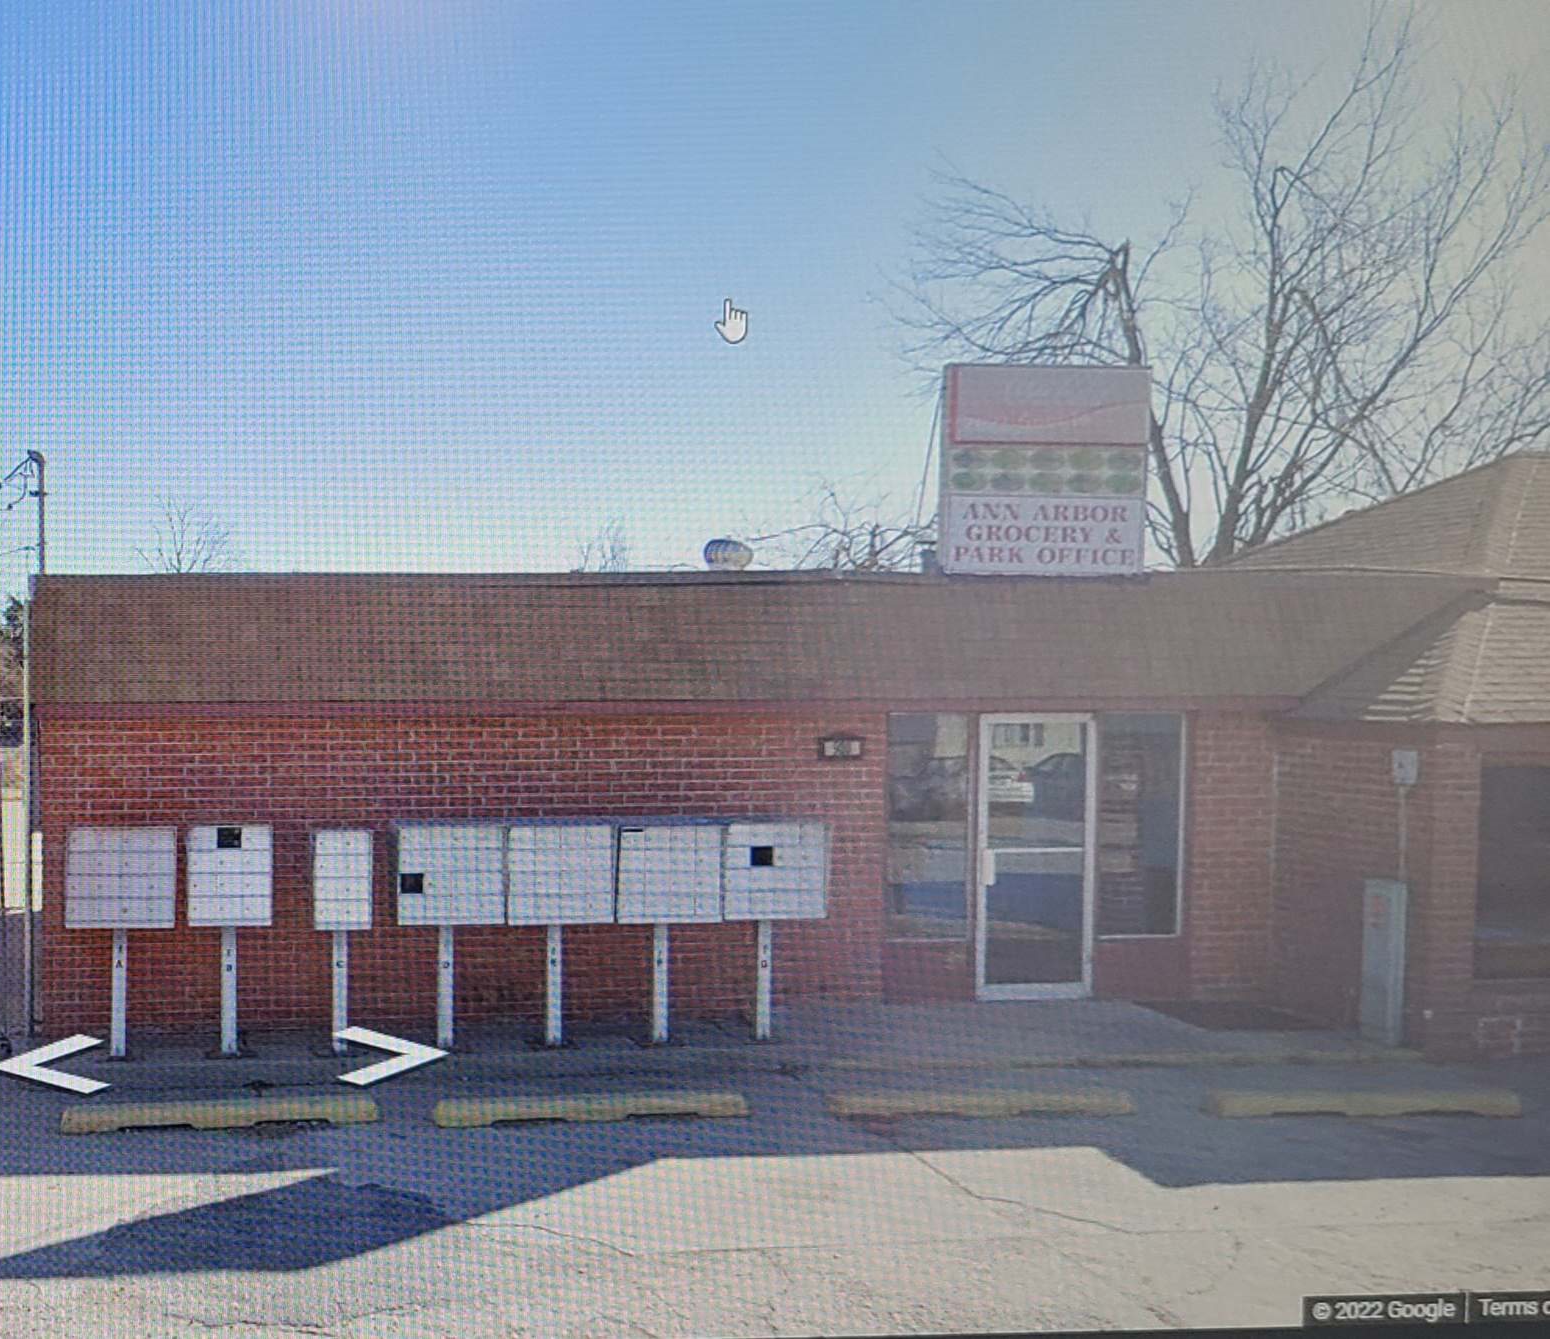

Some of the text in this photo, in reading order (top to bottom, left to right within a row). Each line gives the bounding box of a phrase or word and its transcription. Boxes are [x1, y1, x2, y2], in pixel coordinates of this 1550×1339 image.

[963, 503, 1128, 523] ANN ARBOR
[965, 524, 1123, 544] GROCERY &
[953, 546, 1135, 567] PARK OFFICE
[1334, 1301, 1384, 1320] 2022
[1387, 1298, 1456, 1323] Google
[1477, 1298, 1539, 1316] Terms
